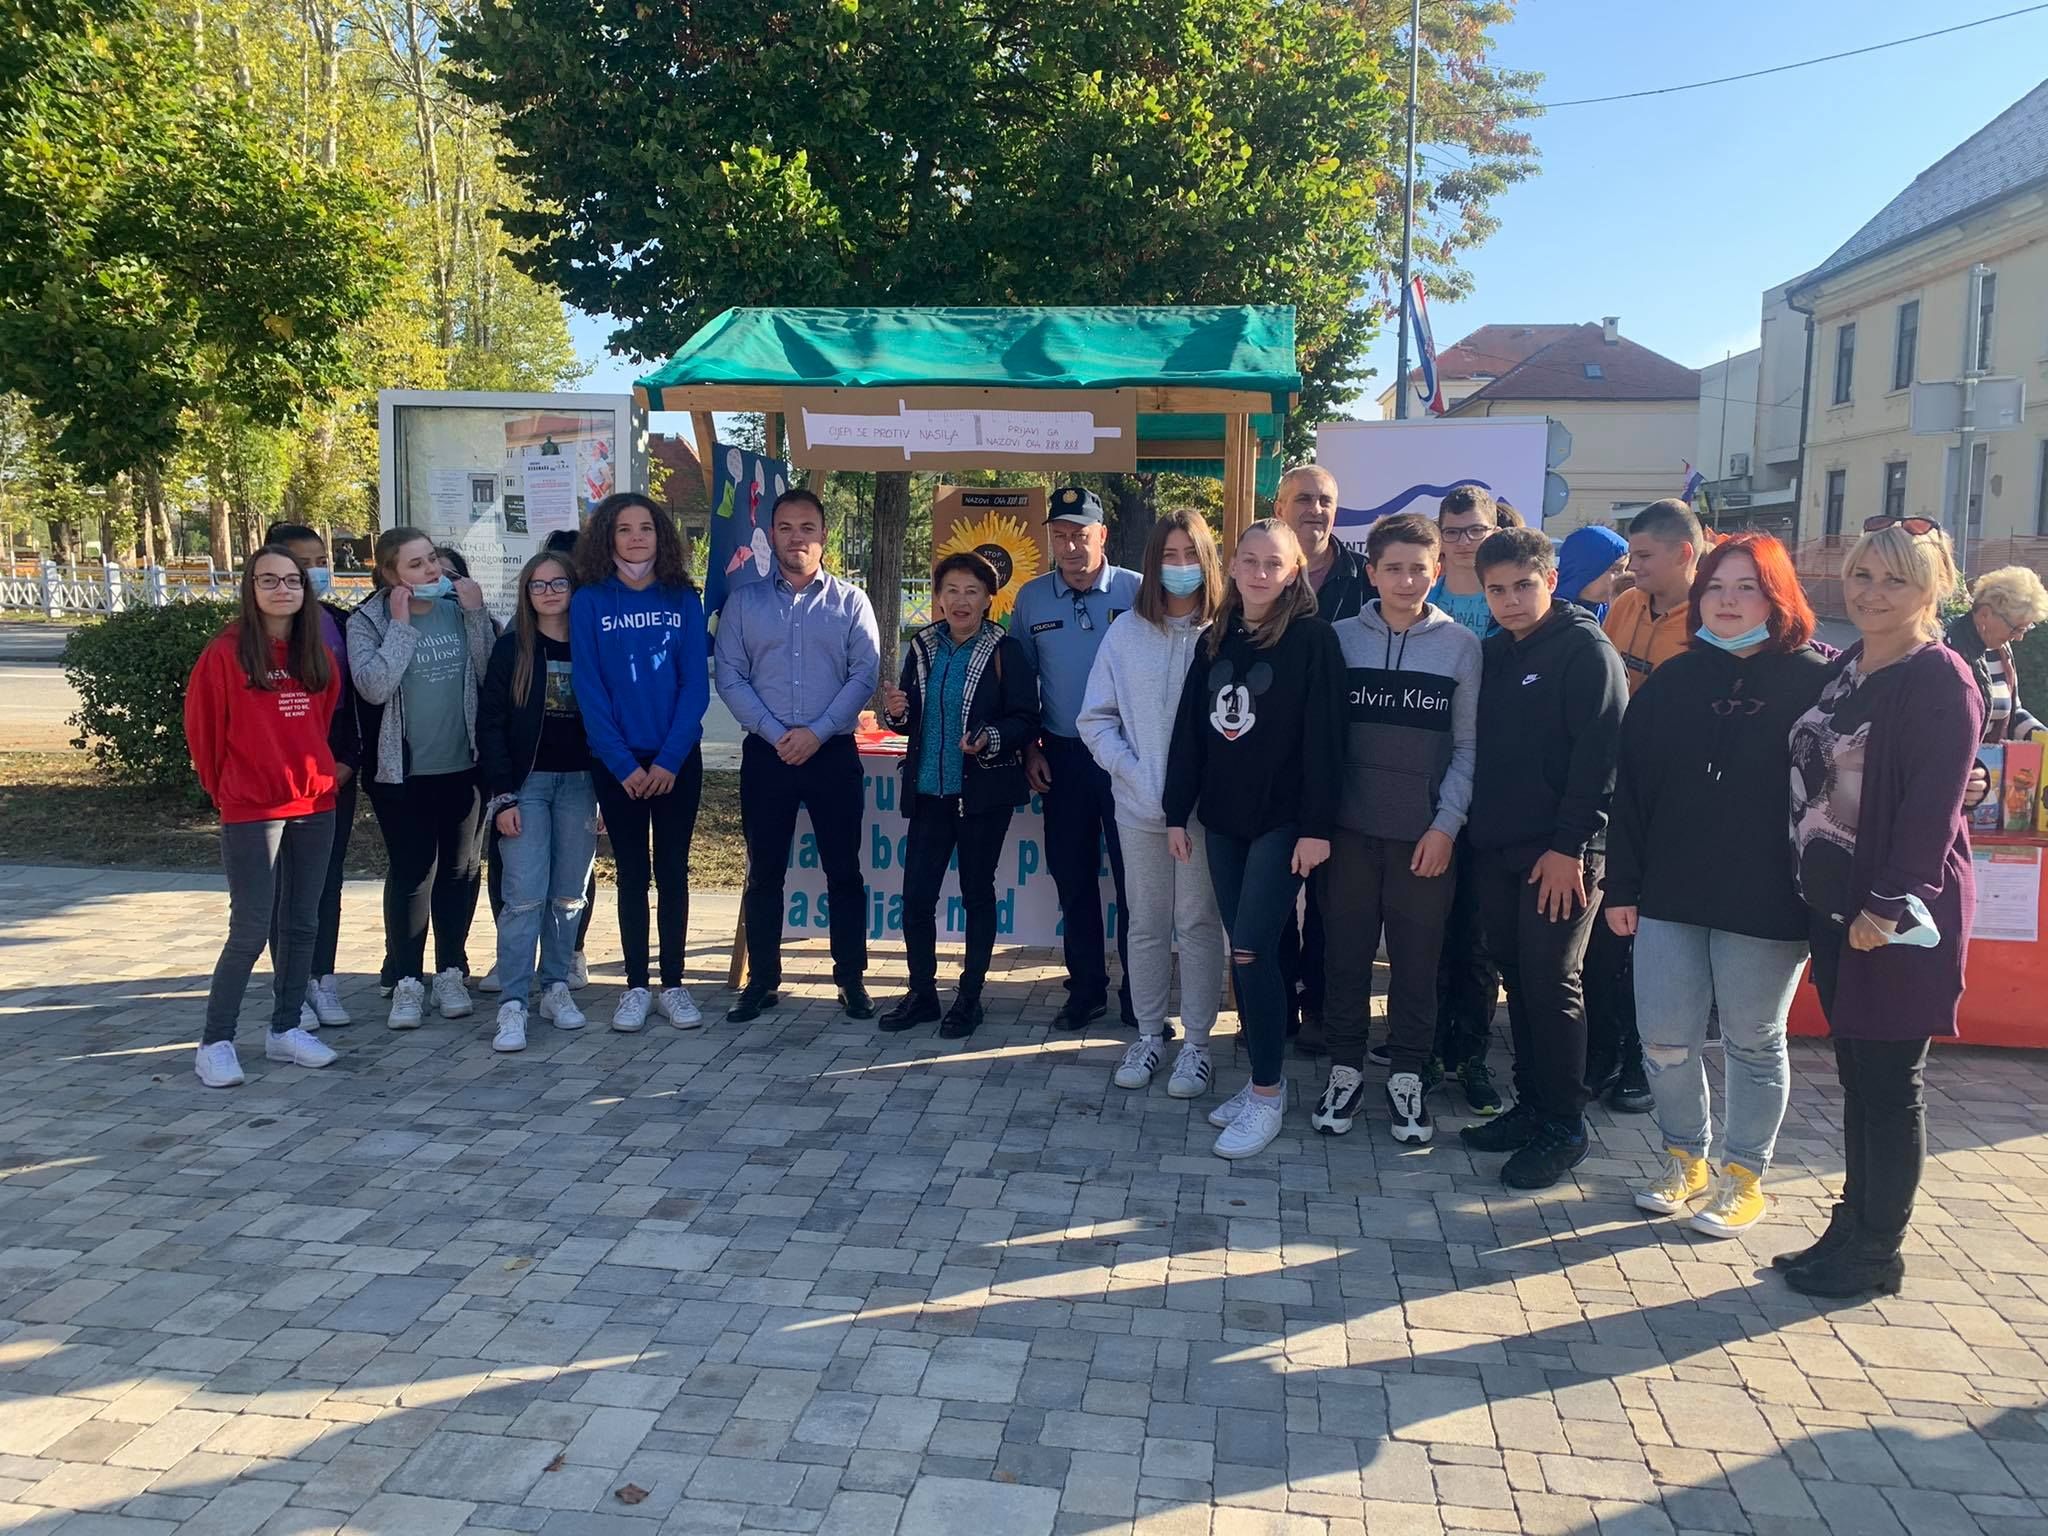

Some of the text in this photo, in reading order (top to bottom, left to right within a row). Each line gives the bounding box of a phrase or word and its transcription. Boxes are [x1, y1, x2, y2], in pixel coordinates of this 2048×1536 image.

[856, 427, 869, 438] SE
[873, 427, 910, 439] PROTIV
[919, 429, 959, 446] NASILJA
[1047, 428, 1060, 436] GA
[986, 438, 1020, 447] NAZOVI
[1025, 439, 1041, 449] 044
[983, 550, 1002, 558] STOP
[415, 633, 460, 648] othing
[416, 646, 460, 664] to lose
[1350, 686, 1449, 711] alvin Klein
[947, 888, 1015, 935] nd
